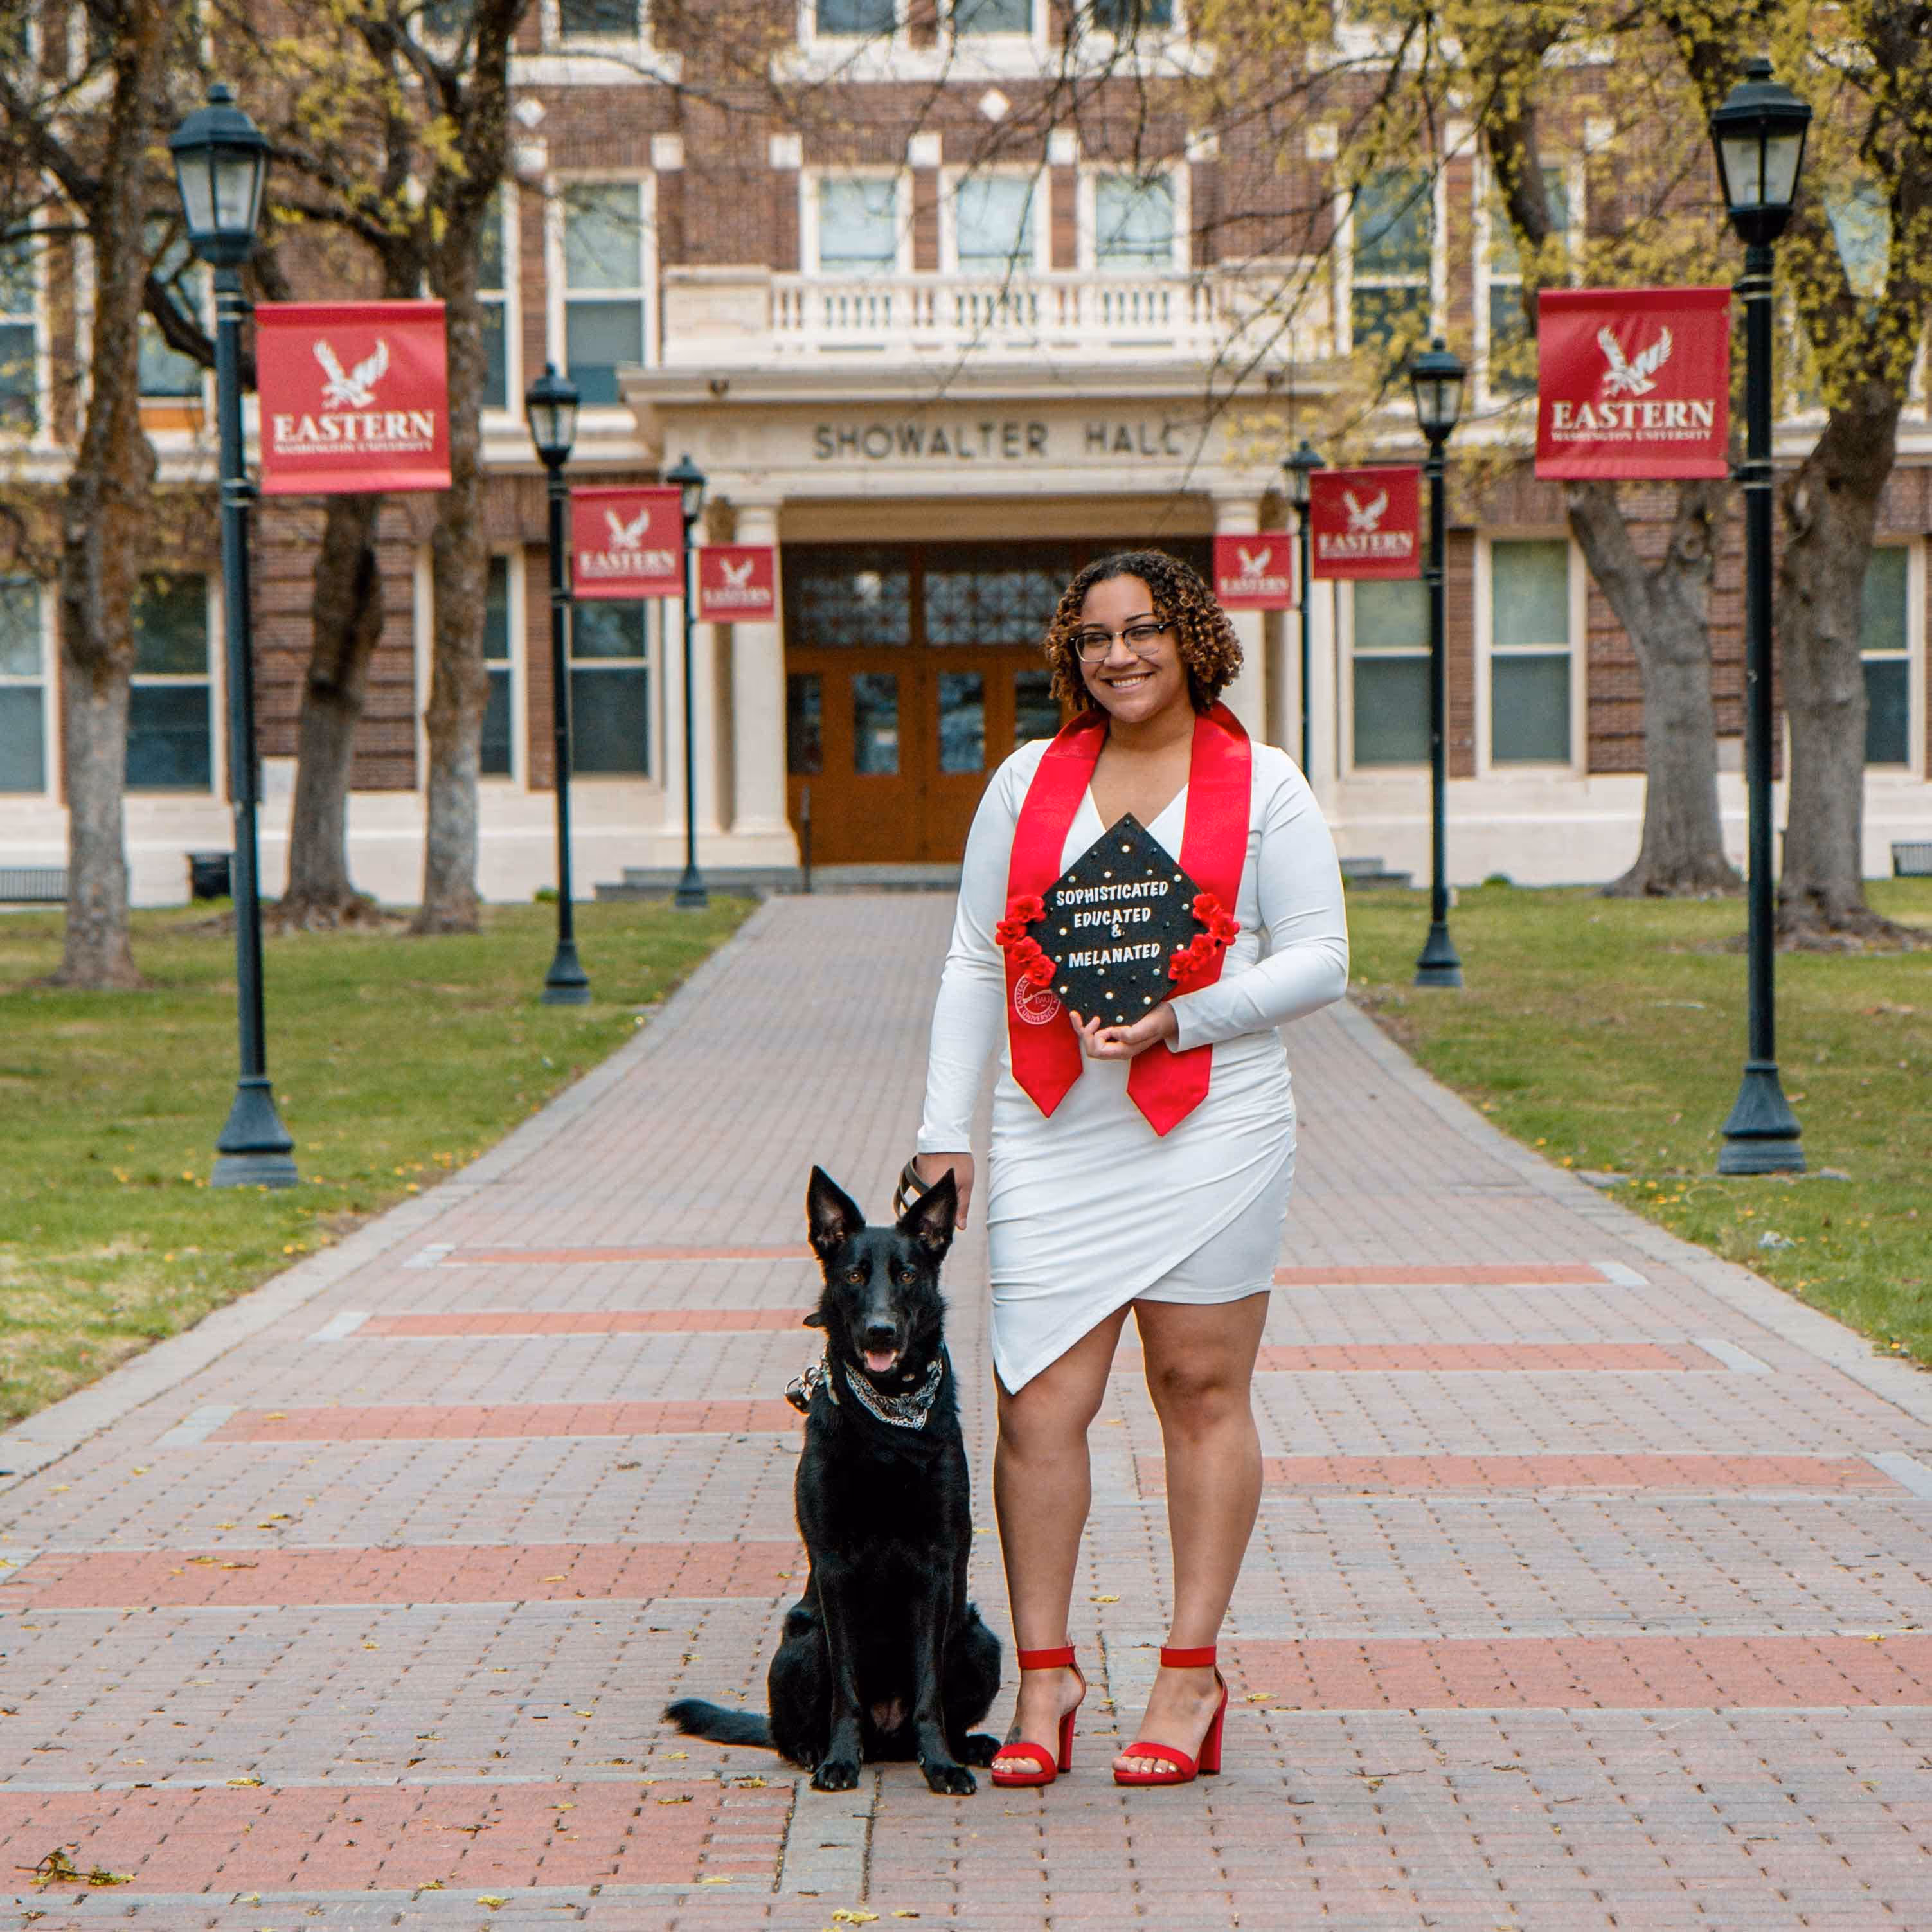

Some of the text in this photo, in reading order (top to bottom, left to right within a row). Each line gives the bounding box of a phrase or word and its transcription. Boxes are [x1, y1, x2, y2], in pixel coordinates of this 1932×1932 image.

[1552, 398, 1716, 429] EASTERN
[273, 411, 434, 442] EASTERN
[813, 420, 1183, 459] SHOWALTER HALL
[1318, 531, 1413, 551] EASTERN
[579, 550, 675, 571] EASTERN
[1056, 881, 1168, 906] SOPHISTICATED
[1074, 907, 1151, 928] EDUCATED
[1111, 924, 1122, 938] &
[1069, 943, 1161, 968] MELANATED
